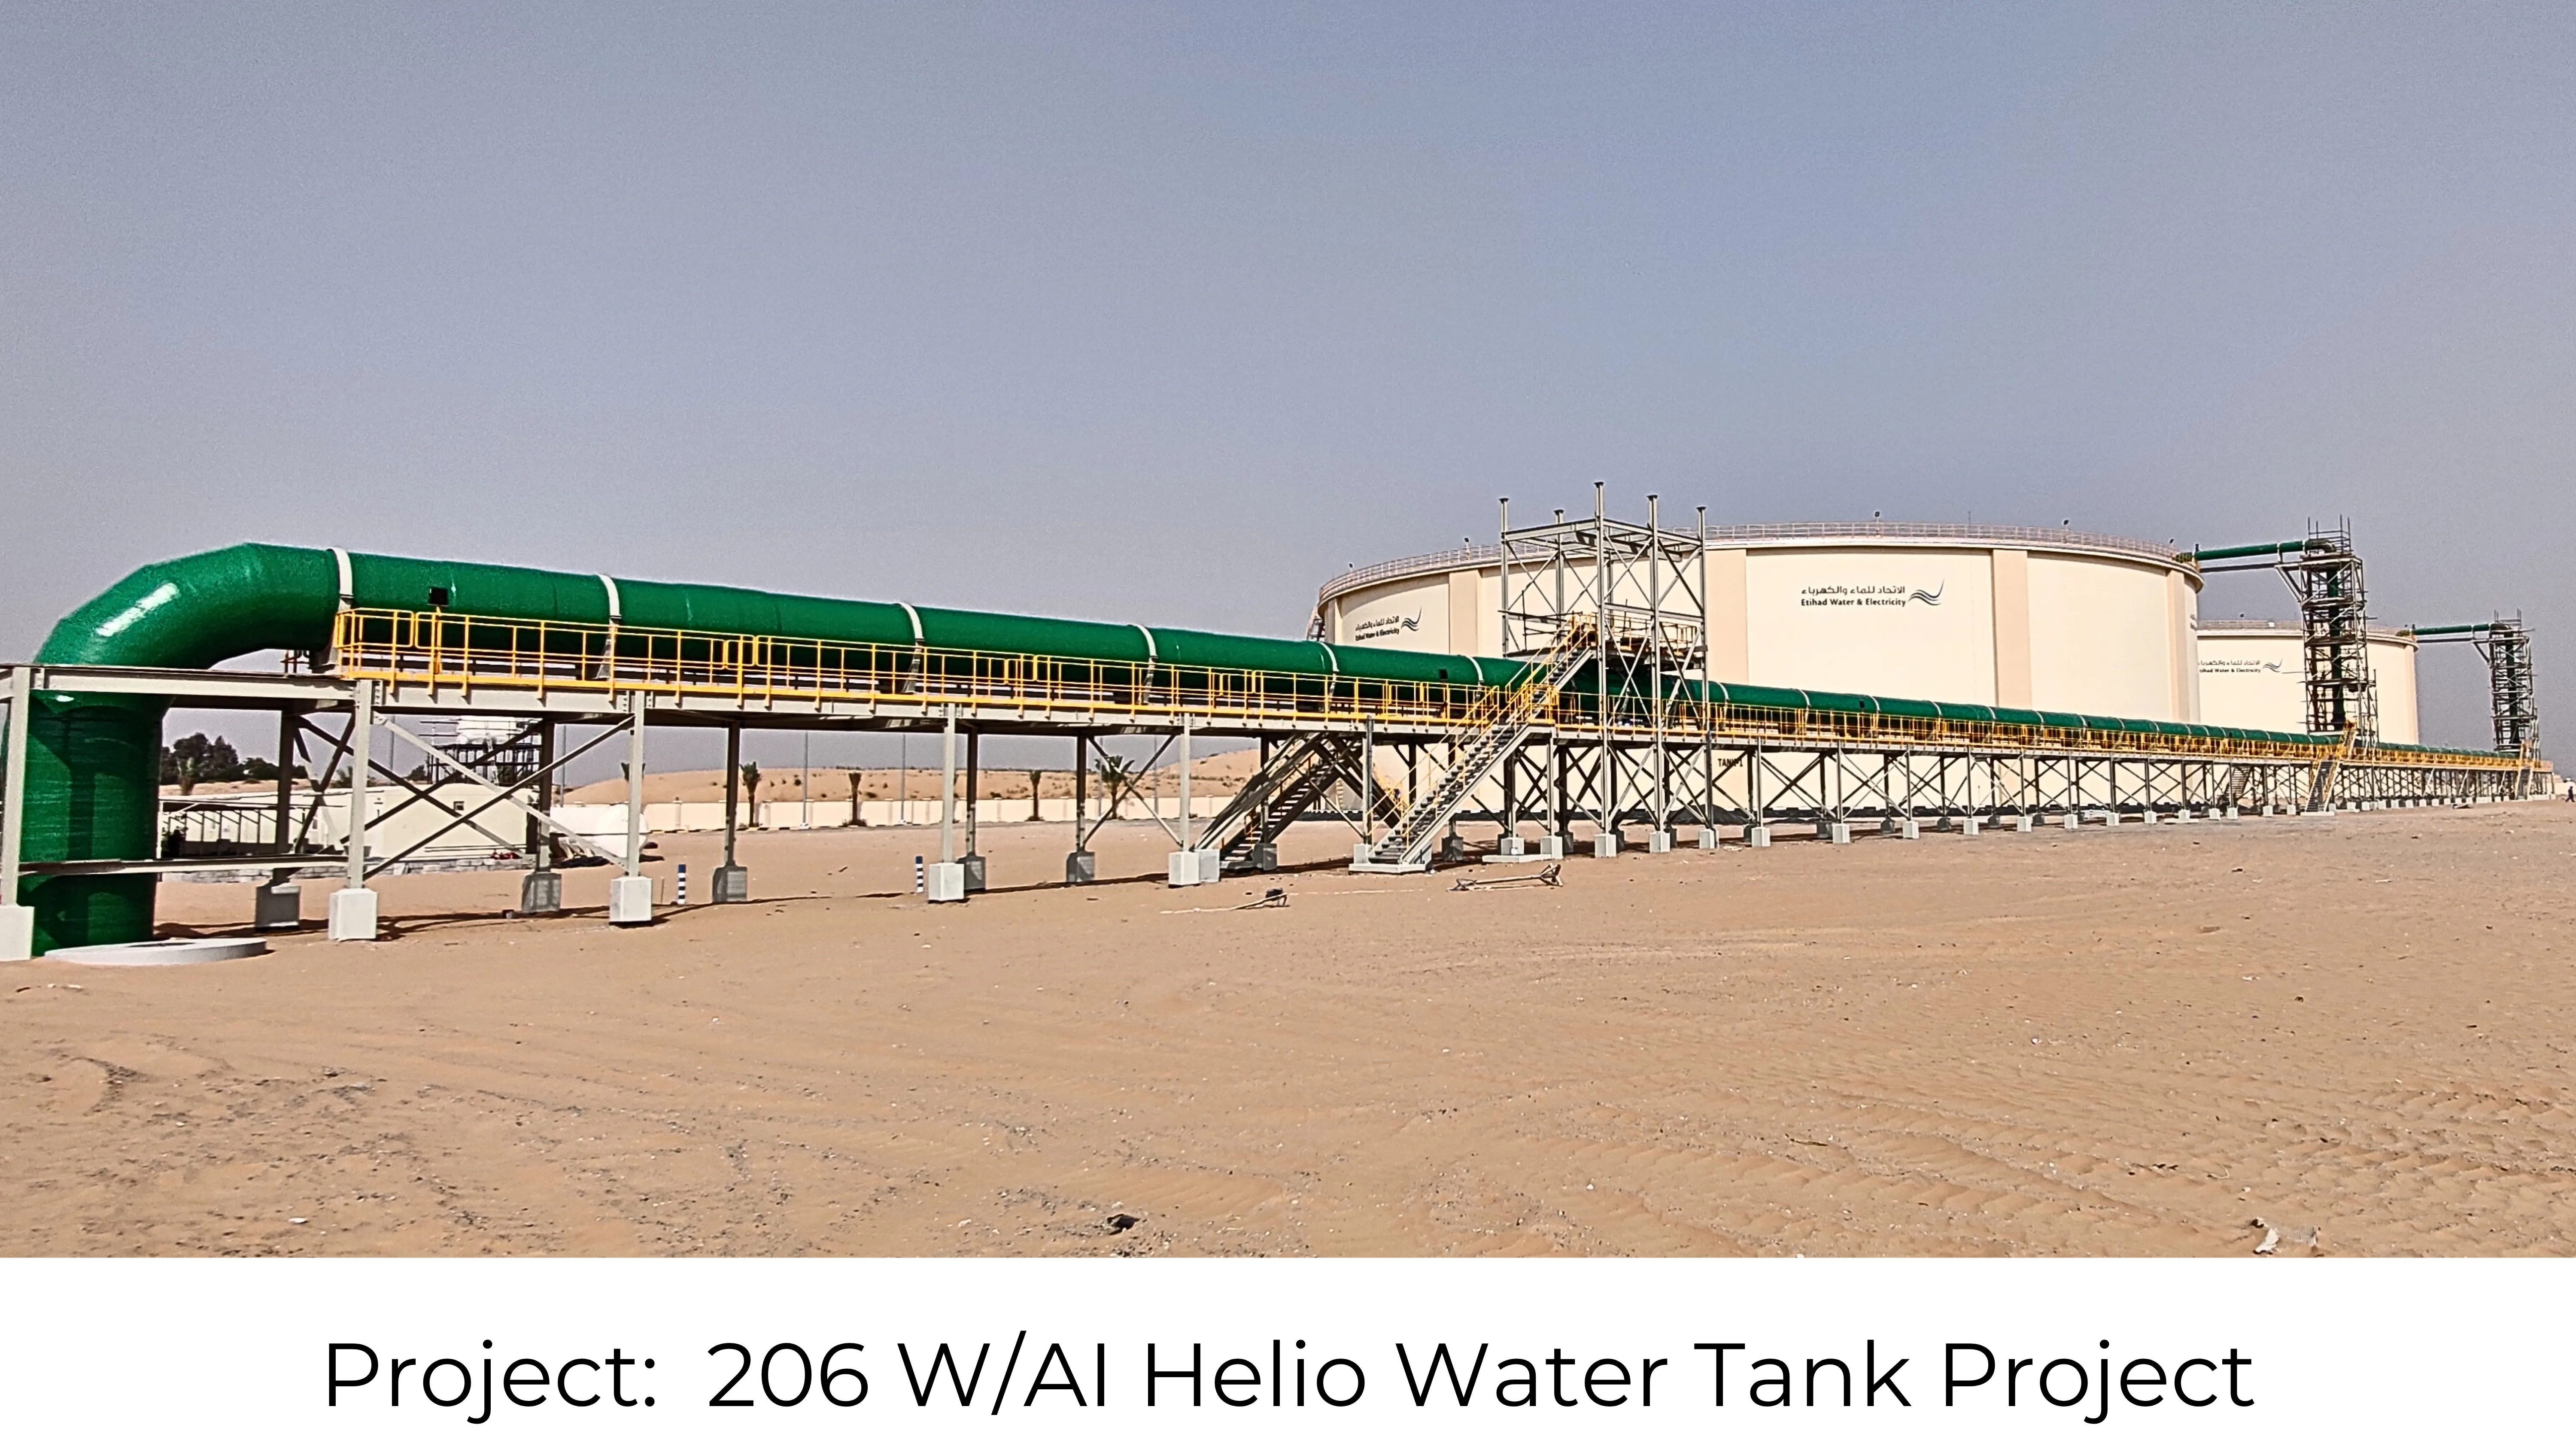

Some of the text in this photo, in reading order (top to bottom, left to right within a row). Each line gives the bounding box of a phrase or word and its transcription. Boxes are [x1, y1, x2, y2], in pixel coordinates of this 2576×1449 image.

[1801, 586, 1848, 596] والكهرباء
[1877, 586, 1905, 594] الاتحاد
[1865, 598, 1906, 608] Electricity
